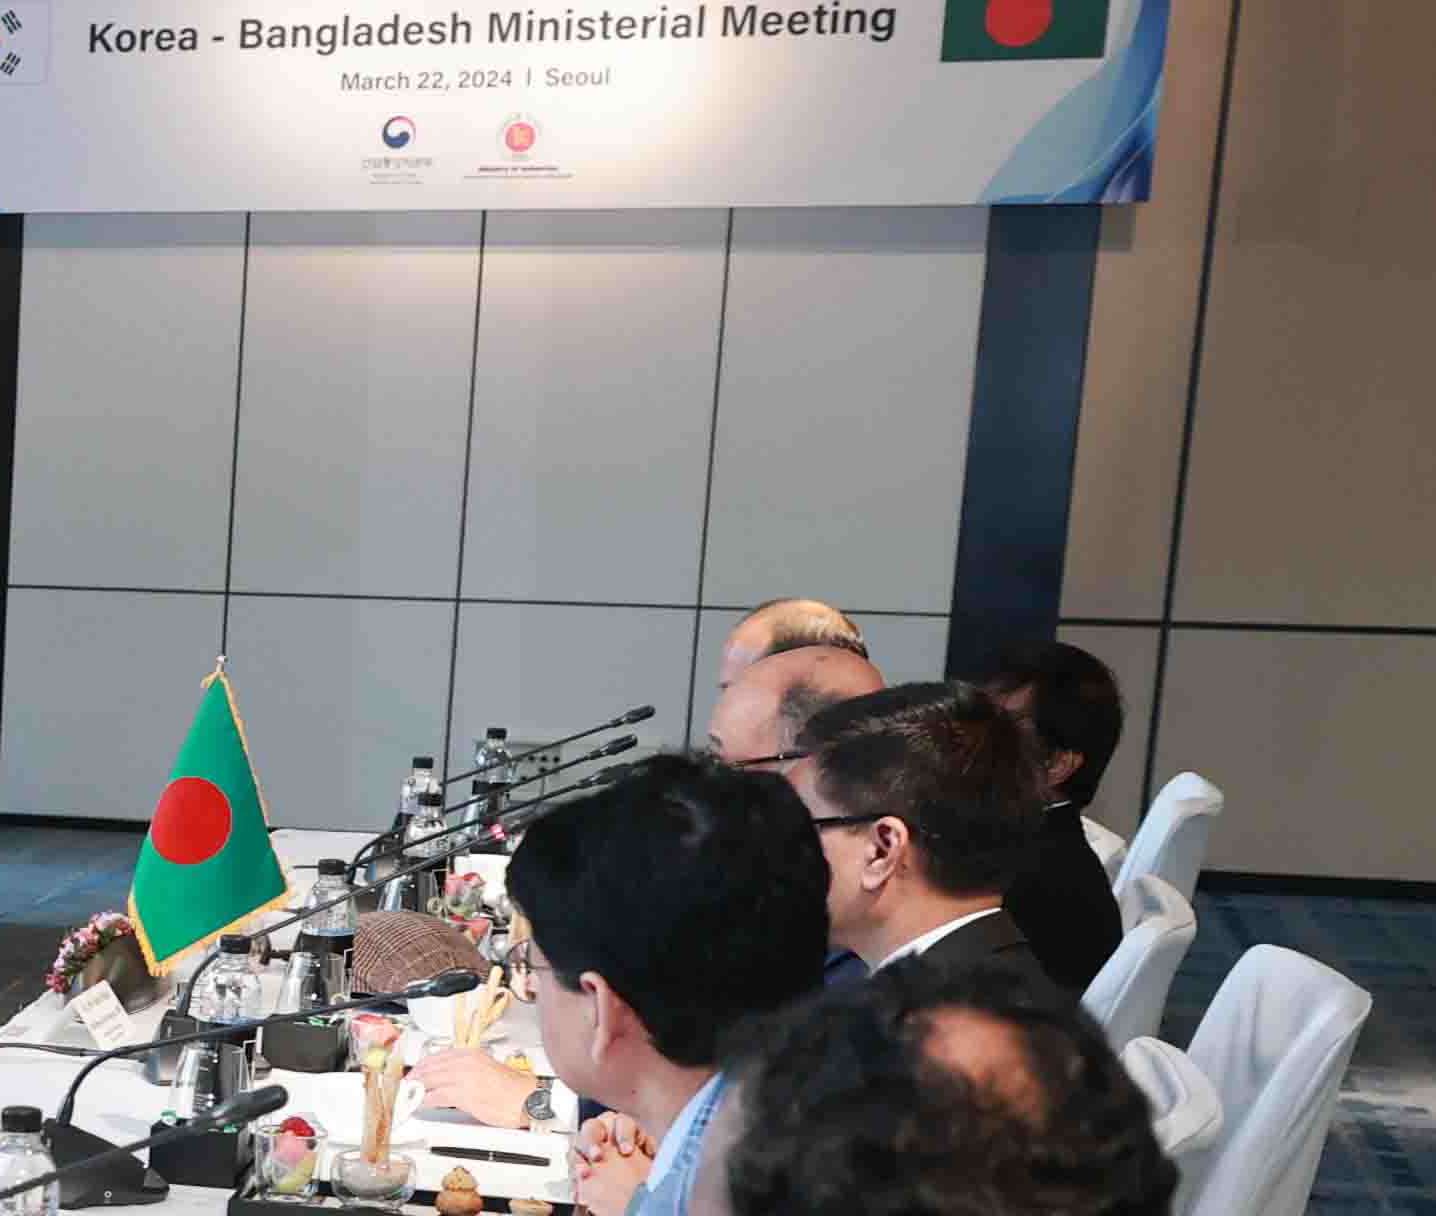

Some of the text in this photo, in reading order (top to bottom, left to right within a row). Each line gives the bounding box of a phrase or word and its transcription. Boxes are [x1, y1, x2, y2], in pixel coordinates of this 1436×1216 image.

[88, 22, 199, 54] Korea
[238, 12, 473, 57] Bangladesh
[487, 5, 706, 44] Ministerial
[720, 1, 897, 43] Meeting
[340, 70, 411, 92] March
[416, 71, 451, 92] 22,
[458, 68, 513, 91] 2024
[544, 65, 612, 88] Seoul
